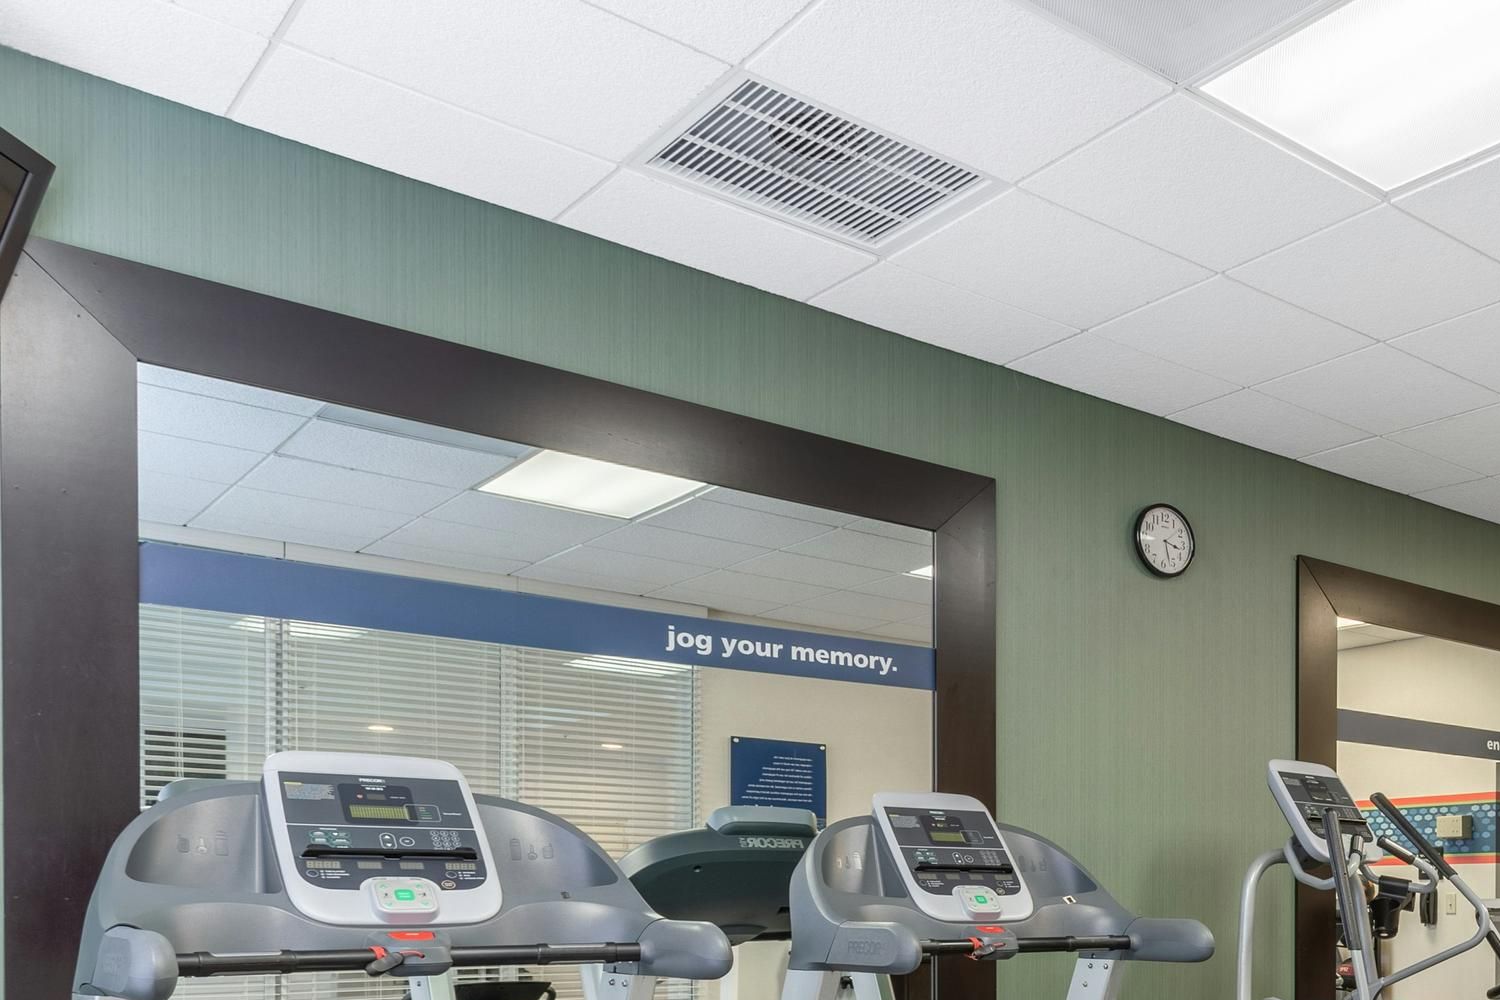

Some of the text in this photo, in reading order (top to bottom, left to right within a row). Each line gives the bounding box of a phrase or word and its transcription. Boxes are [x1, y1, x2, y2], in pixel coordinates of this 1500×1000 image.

[1152, 514, 1159, 525] 11
[1161, 512, 1170, 523] 12
[1145, 521, 1154, 531] 10
[1177, 529, 1183, 539] 2
[1144, 544, 1151, 553] 8
[1180, 541, 1186, 551] 3
[1152, 553, 1157, 564] 7
[1170, 558, 1176, 568] 5
[1160, 560, 1167, 569] 6
[666, 625, 898, 676] jog your memory.
